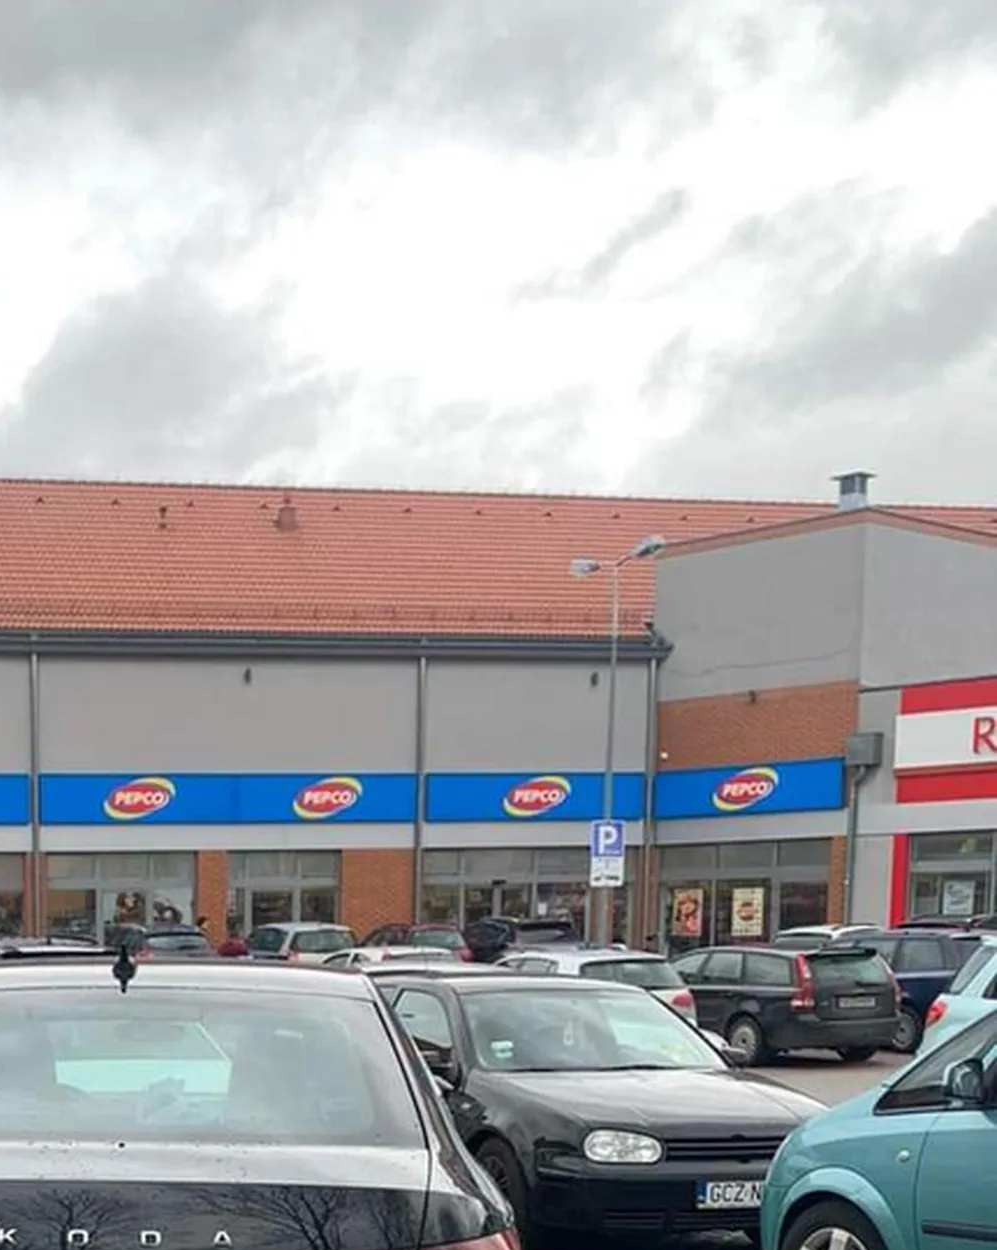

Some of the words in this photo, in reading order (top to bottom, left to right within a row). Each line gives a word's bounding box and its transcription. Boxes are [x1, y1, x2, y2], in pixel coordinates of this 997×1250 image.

[513, 788, 560, 803] PEPCO
[721, 780, 768, 798] PEPCO
[114, 790, 163, 806] PEPCO
[303, 790, 352, 806] PEPCO
[598, 825, 618, 855] P
